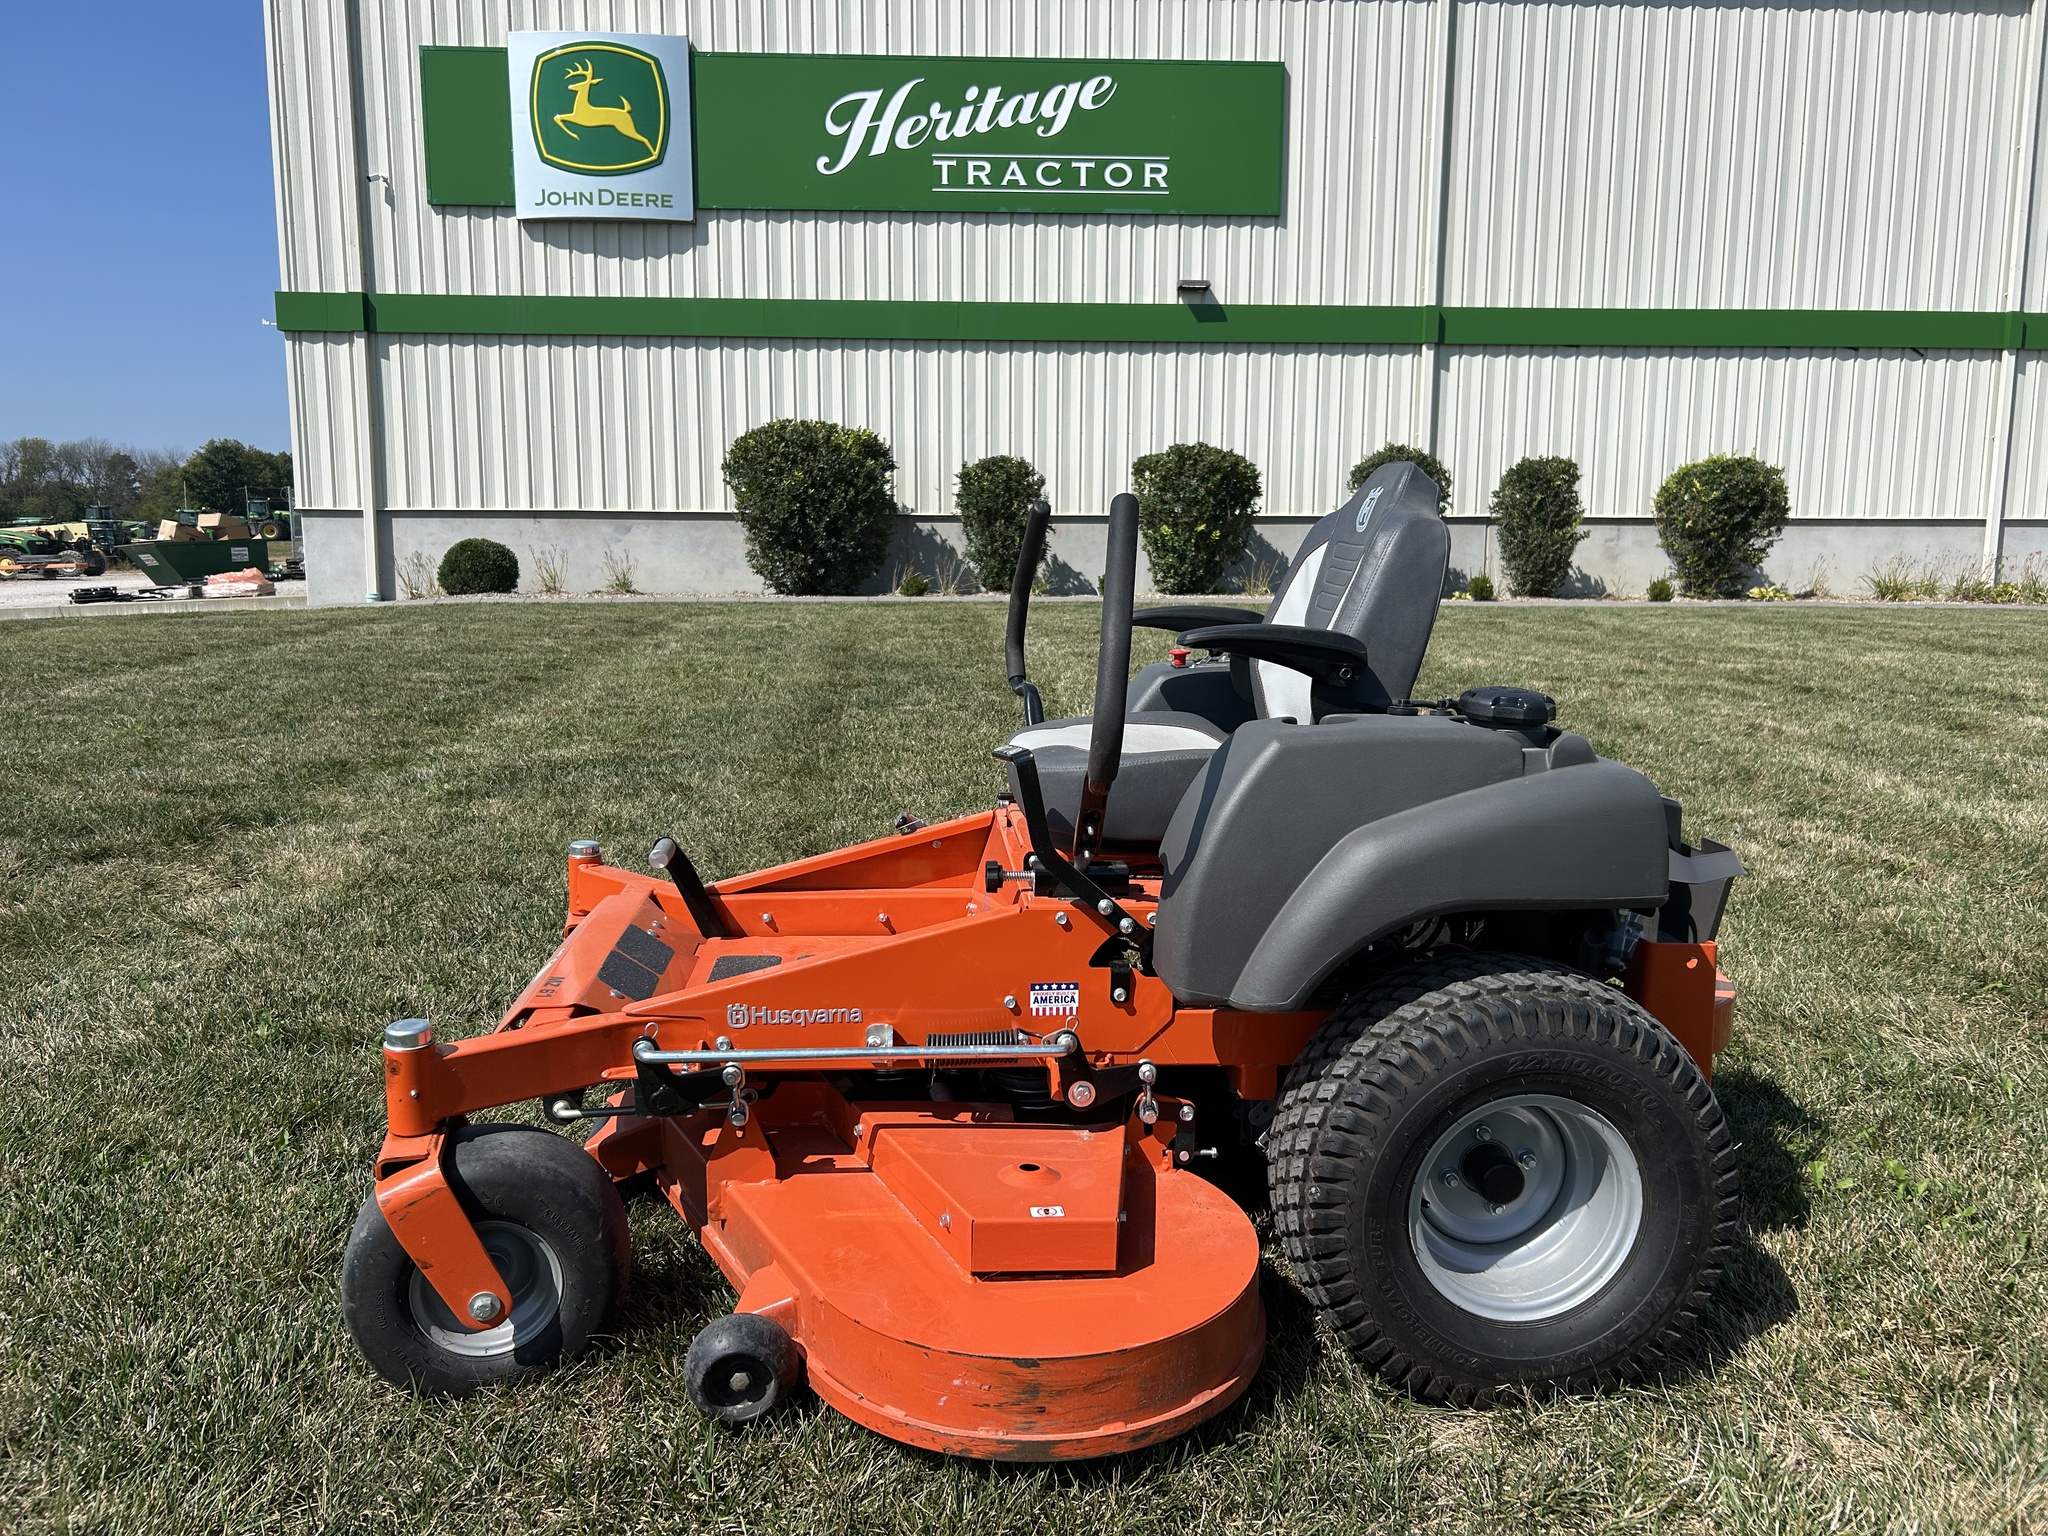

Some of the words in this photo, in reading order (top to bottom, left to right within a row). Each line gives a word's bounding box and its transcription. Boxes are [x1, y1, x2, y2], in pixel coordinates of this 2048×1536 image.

[816, 75, 1118, 175] Heritage
[932, 159, 1169, 187] TRACTOR
[535, 189, 594, 206] JOHN
[598, 188, 673, 208] DEERE
[536, 988, 558, 997] 61
[544, 976, 565, 987] MZ
[1033, 995, 1076, 1004] AMERICA
[751, 1006, 863, 1027] Husqvarna
[550, 1212, 567, 1226] PLY
[565, 1225, 587, 1251] RATING
[1369, 1217, 1387, 1274] TURF
[376, 1290, 388, 1331] TUBELESS
[1380, 1278, 1481, 1368] COMMERCIAL
